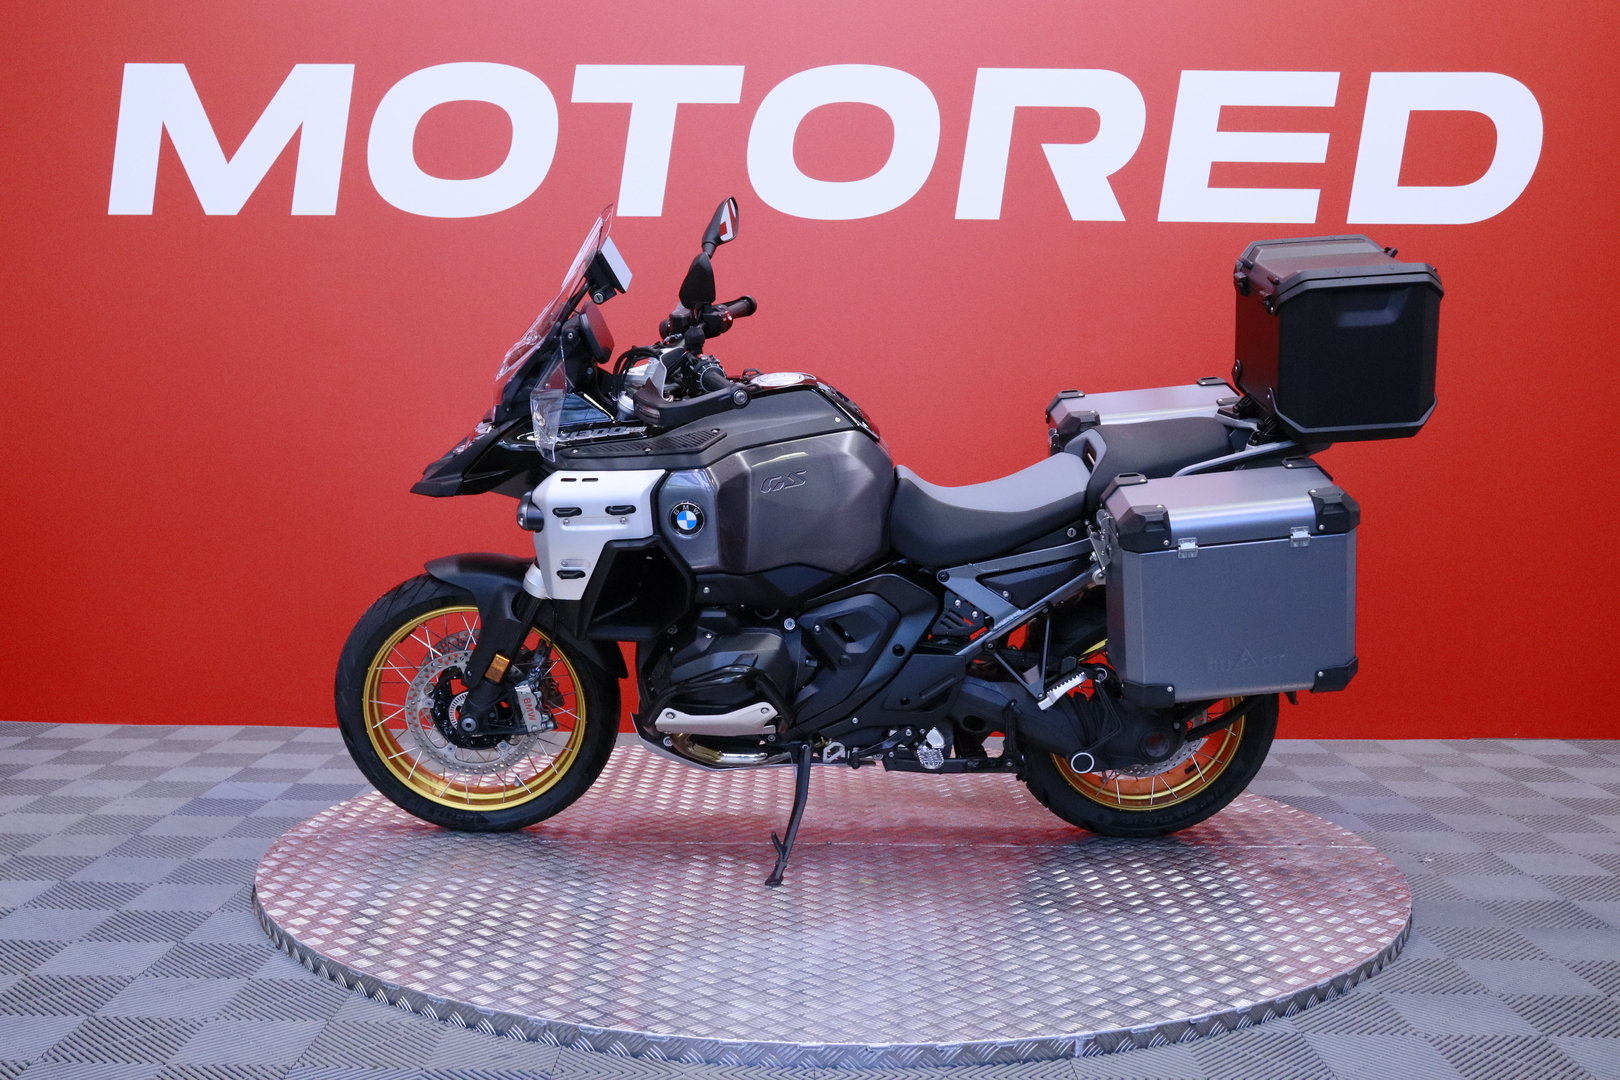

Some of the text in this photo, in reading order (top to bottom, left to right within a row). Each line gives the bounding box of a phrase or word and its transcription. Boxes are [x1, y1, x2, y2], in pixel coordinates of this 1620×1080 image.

[108, 62, 1543, 224] MOTORED
[759, 468, 807, 493] GS
[522, 697, 537, 721] BMW
